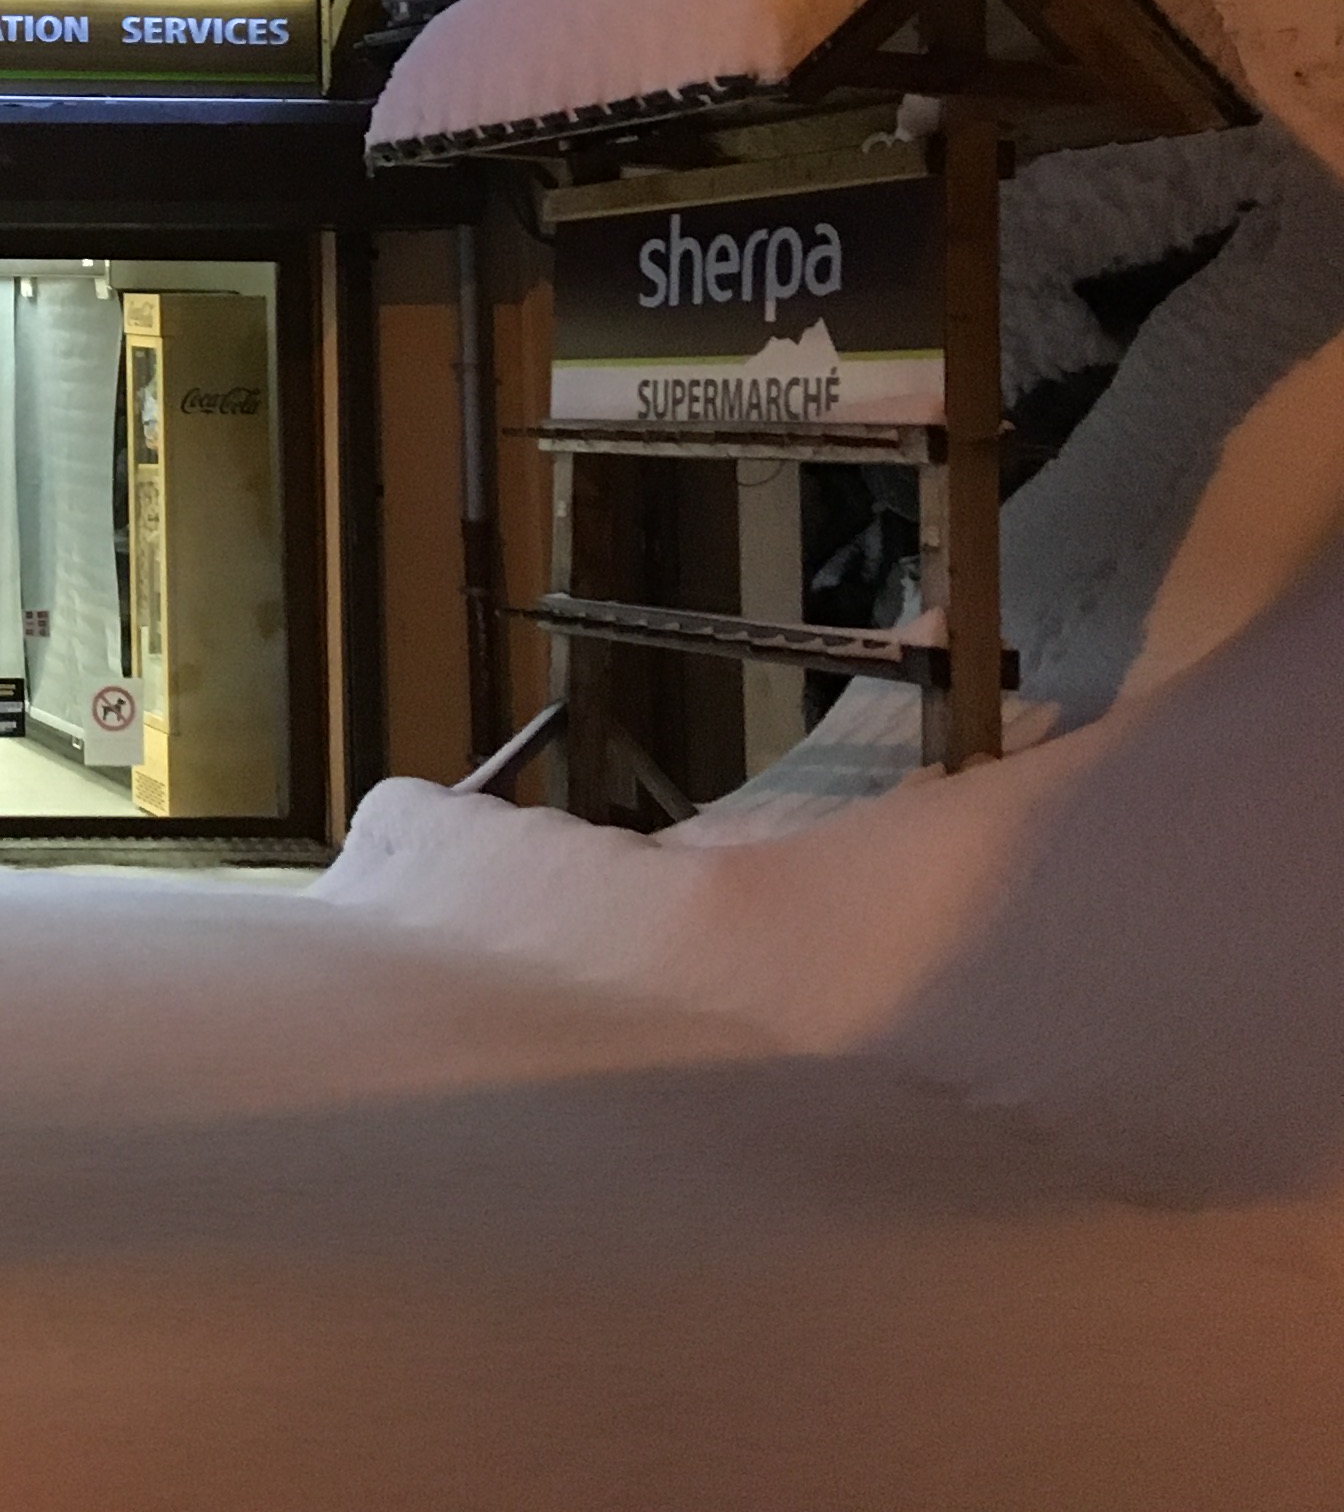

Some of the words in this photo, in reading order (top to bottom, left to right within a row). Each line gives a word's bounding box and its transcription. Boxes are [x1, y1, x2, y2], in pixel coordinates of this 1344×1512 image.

[121, 16, 290, 45] SERVICES
[638, 214, 842, 322] sherpa
[637, 367, 841, 421] SUPERMARCHÉ
